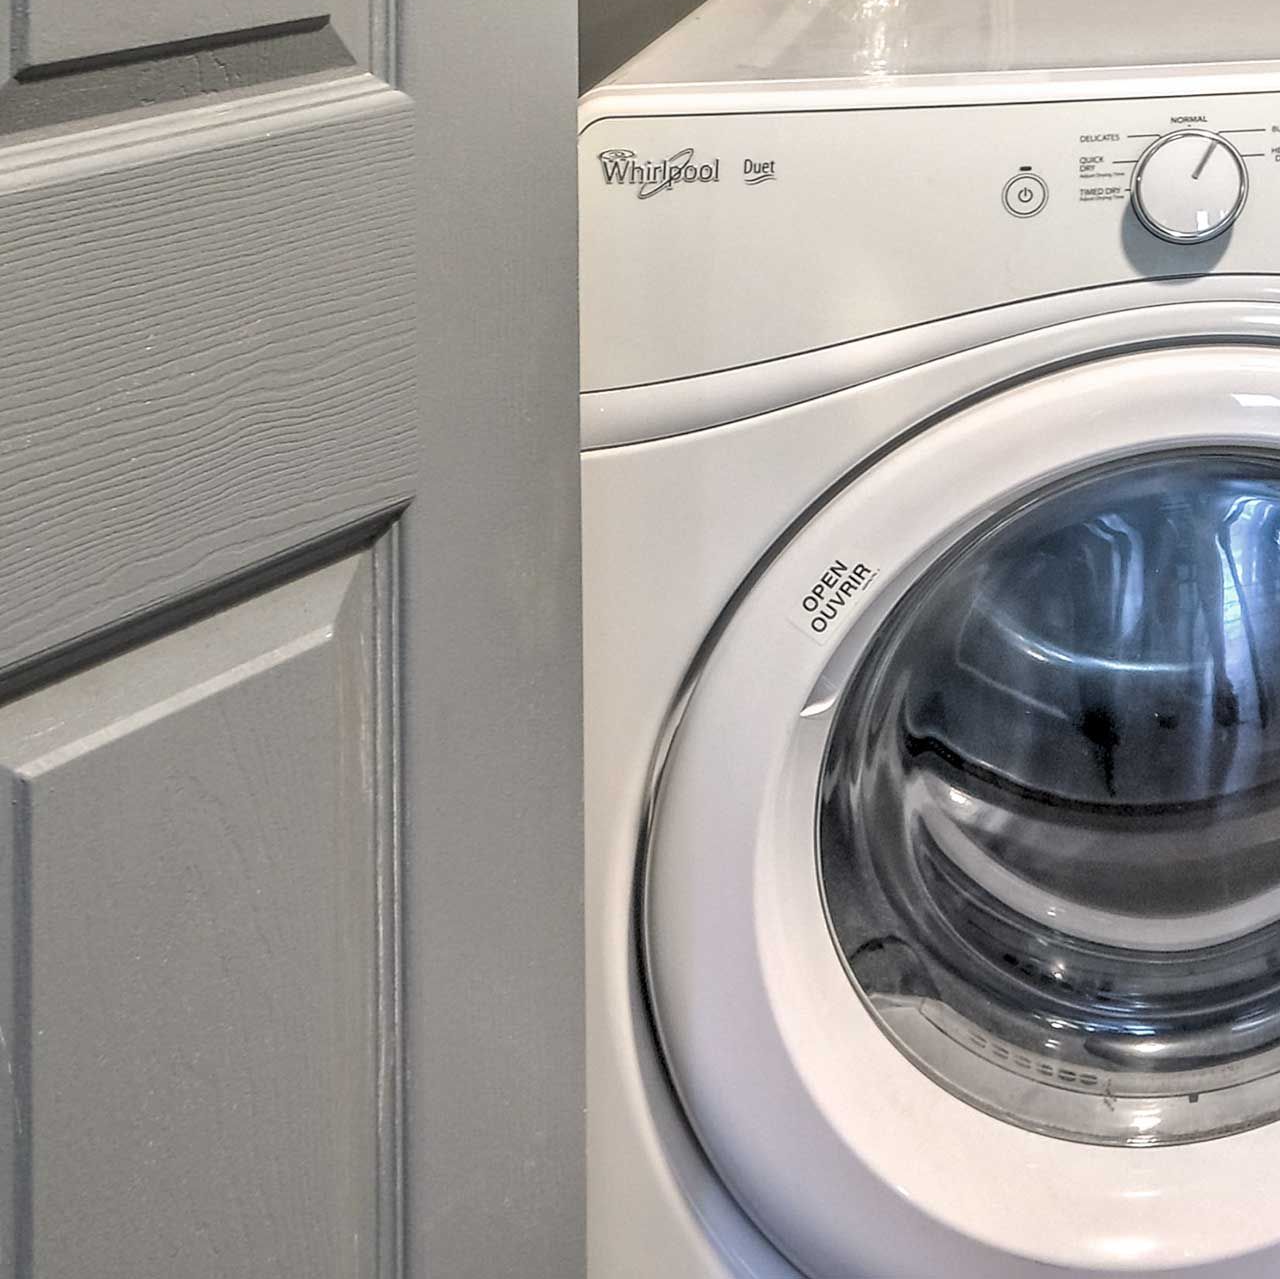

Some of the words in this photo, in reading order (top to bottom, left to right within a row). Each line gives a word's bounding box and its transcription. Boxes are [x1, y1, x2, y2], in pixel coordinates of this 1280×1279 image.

[1079, 134, 1121, 143] DELICATES
[1079, 156, 1104, 164] QUICK
[602, 157, 720, 190] Whirlpool
[743, 158, 776, 175] Duet
[1079, 165, 1096, 173] DRY
[1079, 188, 1104, 196] TIMED
[1105, 187, 1121, 195] DRY
[802, 560, 849, 612] OPEN
[811, 563, 871, 633] OUVRIR
